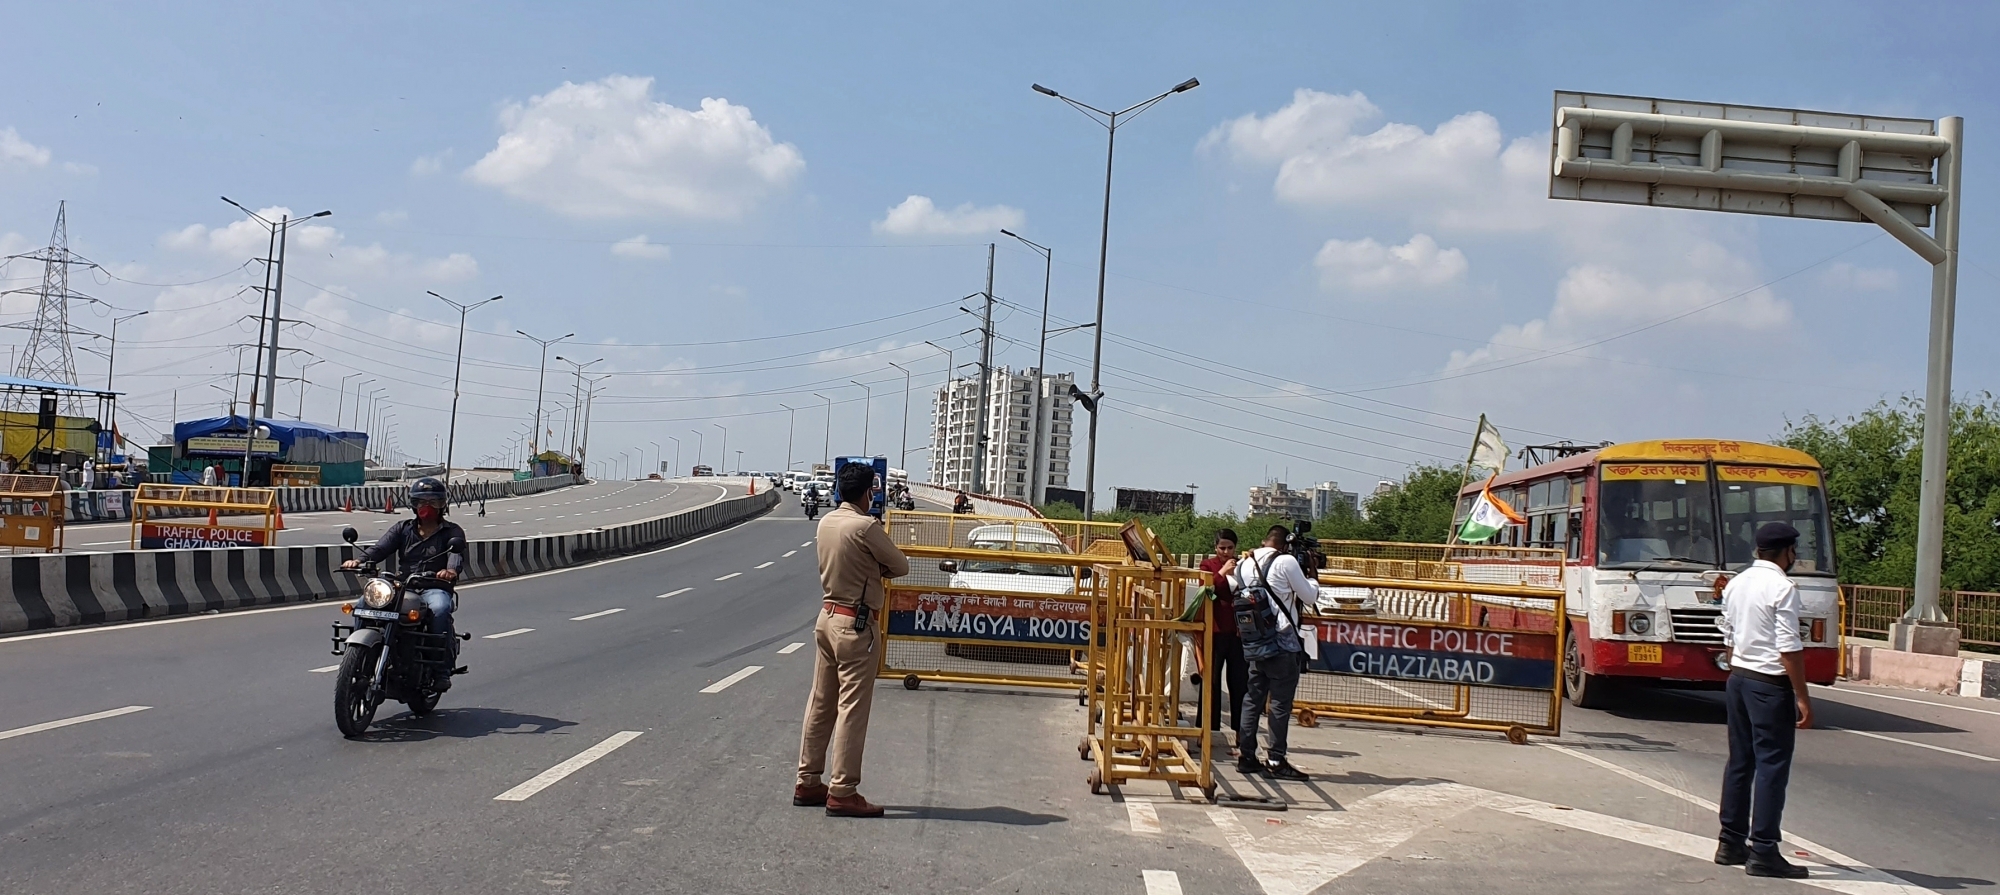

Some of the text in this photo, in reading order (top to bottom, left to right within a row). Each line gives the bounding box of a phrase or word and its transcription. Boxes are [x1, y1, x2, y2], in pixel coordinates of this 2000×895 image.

[1639, 465, 1666, 476] उत्तर
[155, 525, 253, 542] TRAFFIC POLICE
[164, 537, 238, 549] GHAZIABAD
[983, 594, 1008, 607] वैशाली
[1013, 598, 1035, 609] थाना
[914, 609, 1091, 641] RAMAGYA ROOTS
[1321, 620, 1514, 656] TRAFFIC POLICE
[1350, 651, 1494, 683] GHAZIABAD
